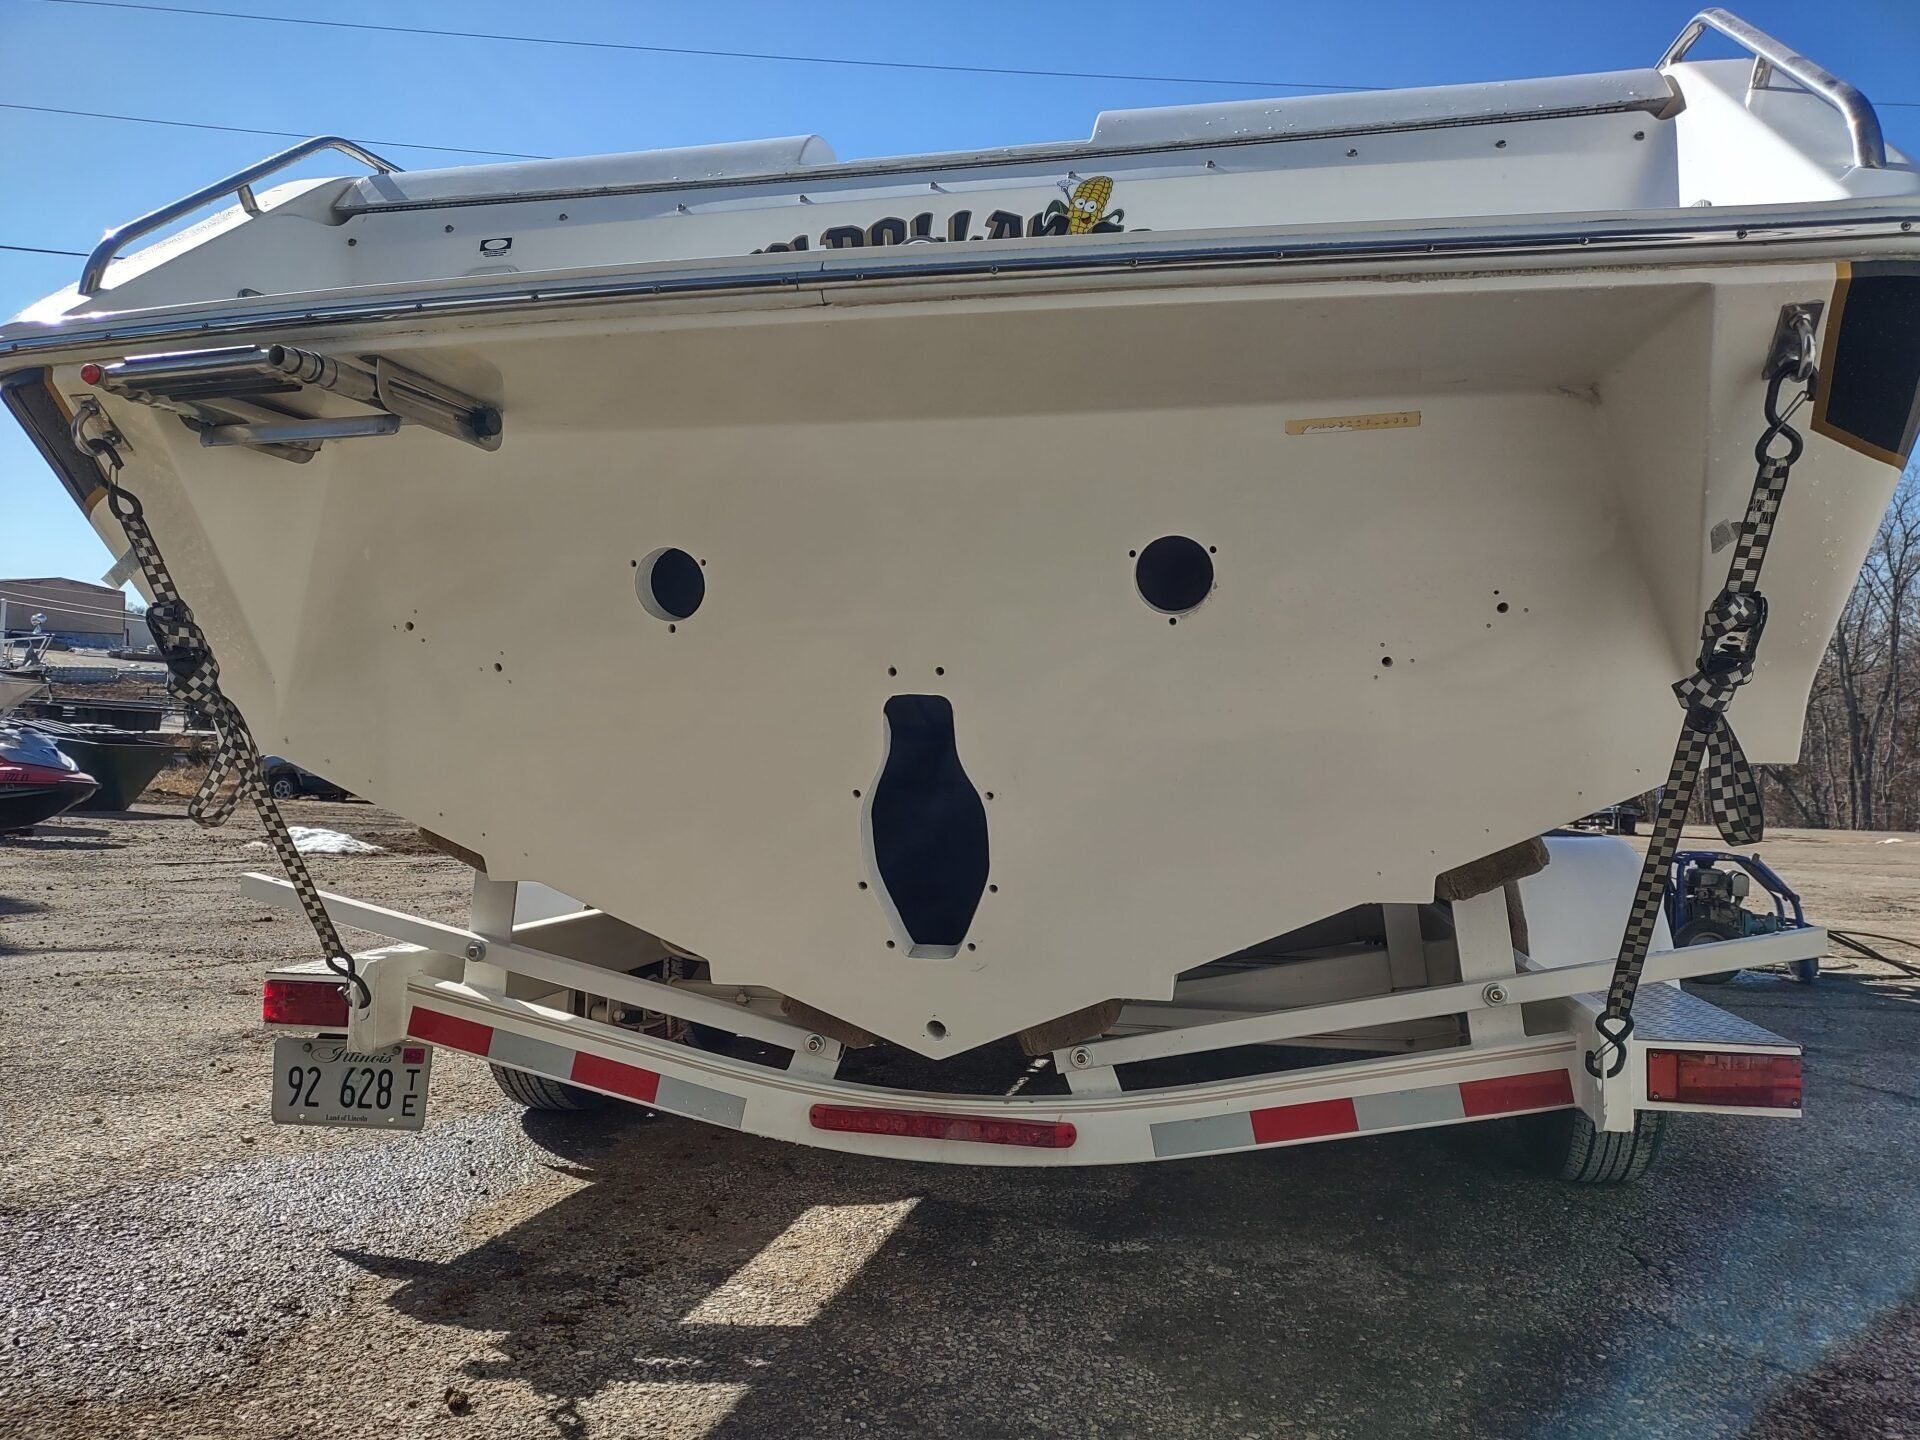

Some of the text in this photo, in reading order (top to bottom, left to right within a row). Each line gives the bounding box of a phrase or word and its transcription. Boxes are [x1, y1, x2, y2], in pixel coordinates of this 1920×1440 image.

[311, 1046, 394, 1064] Illinois
[288, 1066, 322, 1108] 92
[339, 1067, 394, 1110] 628
[325, 1113, 339, 1121] Land
[347, 1114, 368, 1122] Lincoln
